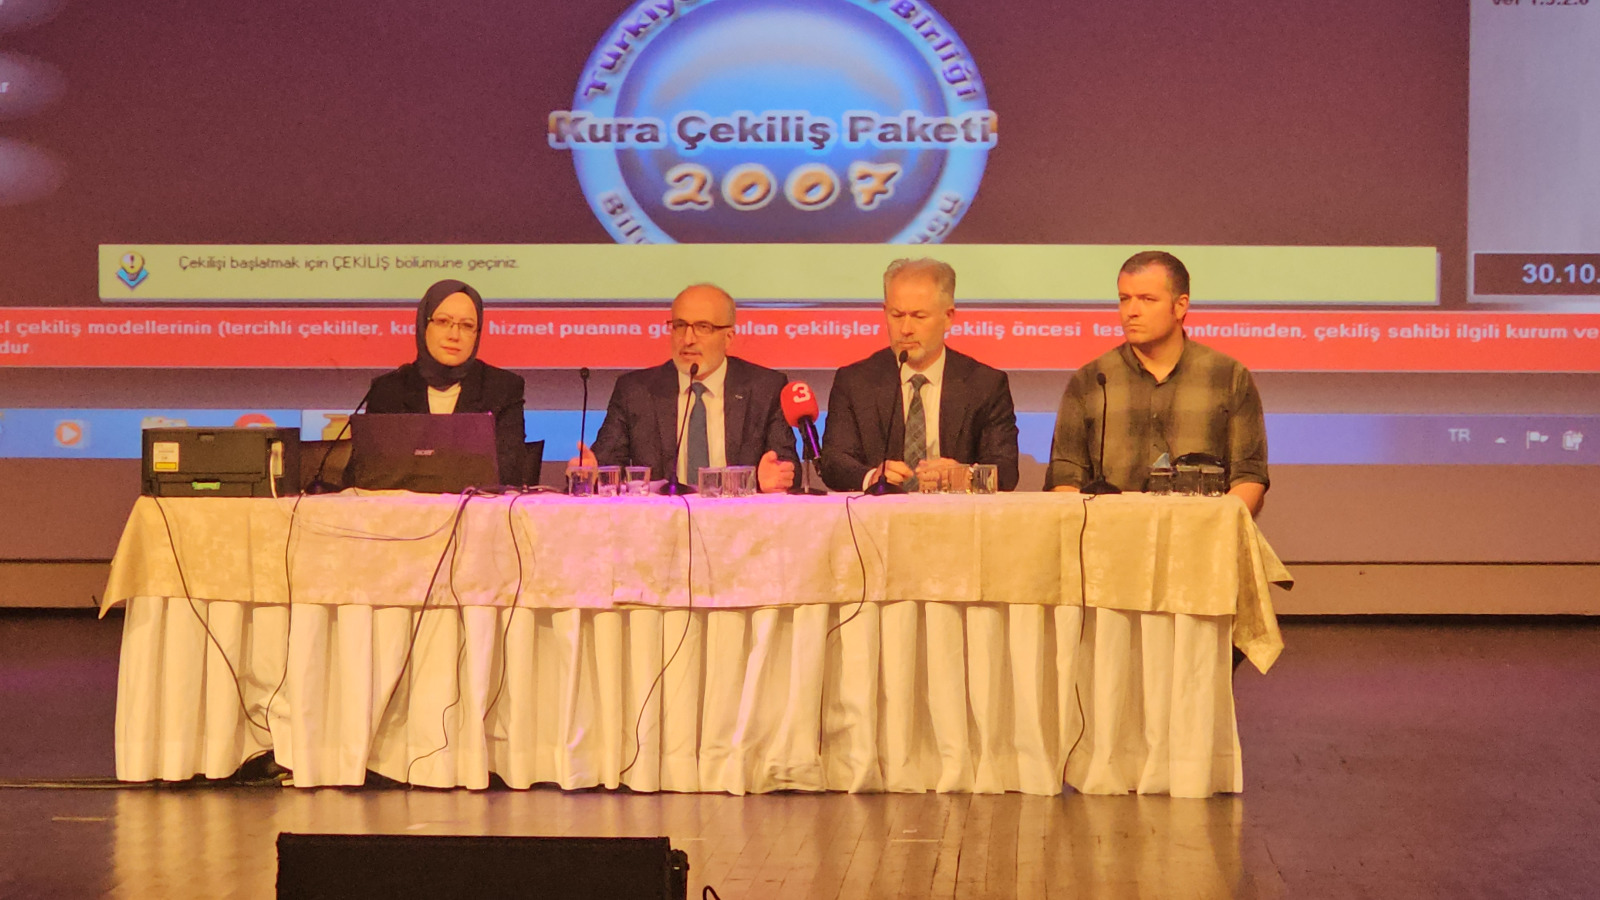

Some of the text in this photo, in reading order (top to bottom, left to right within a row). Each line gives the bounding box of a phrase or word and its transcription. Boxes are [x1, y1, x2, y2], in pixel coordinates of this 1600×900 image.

[551, 114, 992, 150] Kura Çekiliş Paketi
[666, 165, 901, 206] 2007
[178, 255, 226, 271] Çekilişi
[230, 256, 300, 271] başlatmak
[304, 255, 329, 271] için
[332, 254, 390, 271] ÇEKİLİŞ
[395, 255, 463, 269] bölümüne
[16, 319, 82, 337] çekiliş
[88, 320, 212, 335] modellerinin
[217, 320, 293, 338] (tercihli
[488, 320, 555, 336] hizmet
[559, 323, 643, 338] puanına
[785, 320, 881, 340] çekilişler
[944, 320, 1006, 340] ekiliş
[1012, 321, 1082, 336] öncesi
[1314, 323, 1381, 342] çekiliş
[1387, 323, 1451, 339] sahibi
[1456, 323, 1501, 343] ilgili
[1505, 323, 1568, 339] kurum
[1573, 327, 1599, 339] ve
[792, 383, 811, 403] 3
[1448, 428, 1471, 442] TR
